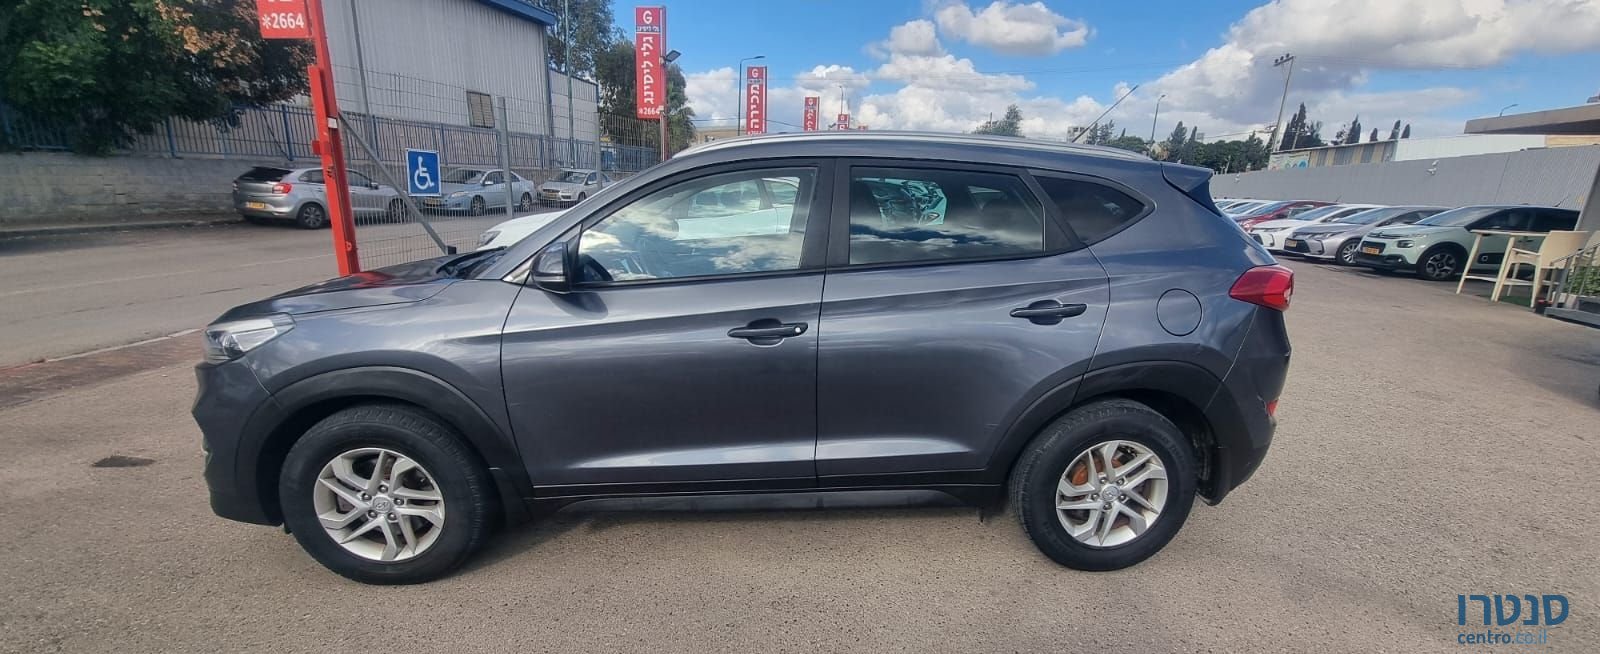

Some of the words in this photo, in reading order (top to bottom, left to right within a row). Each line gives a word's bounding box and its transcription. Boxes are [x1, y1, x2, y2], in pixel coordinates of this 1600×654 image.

[642, 10, 653, 24] G
[641, 36, 654, 57] גלי
[641, 60, 655, 105] ליסינג
[750, 84, 760, 129] מכירה
